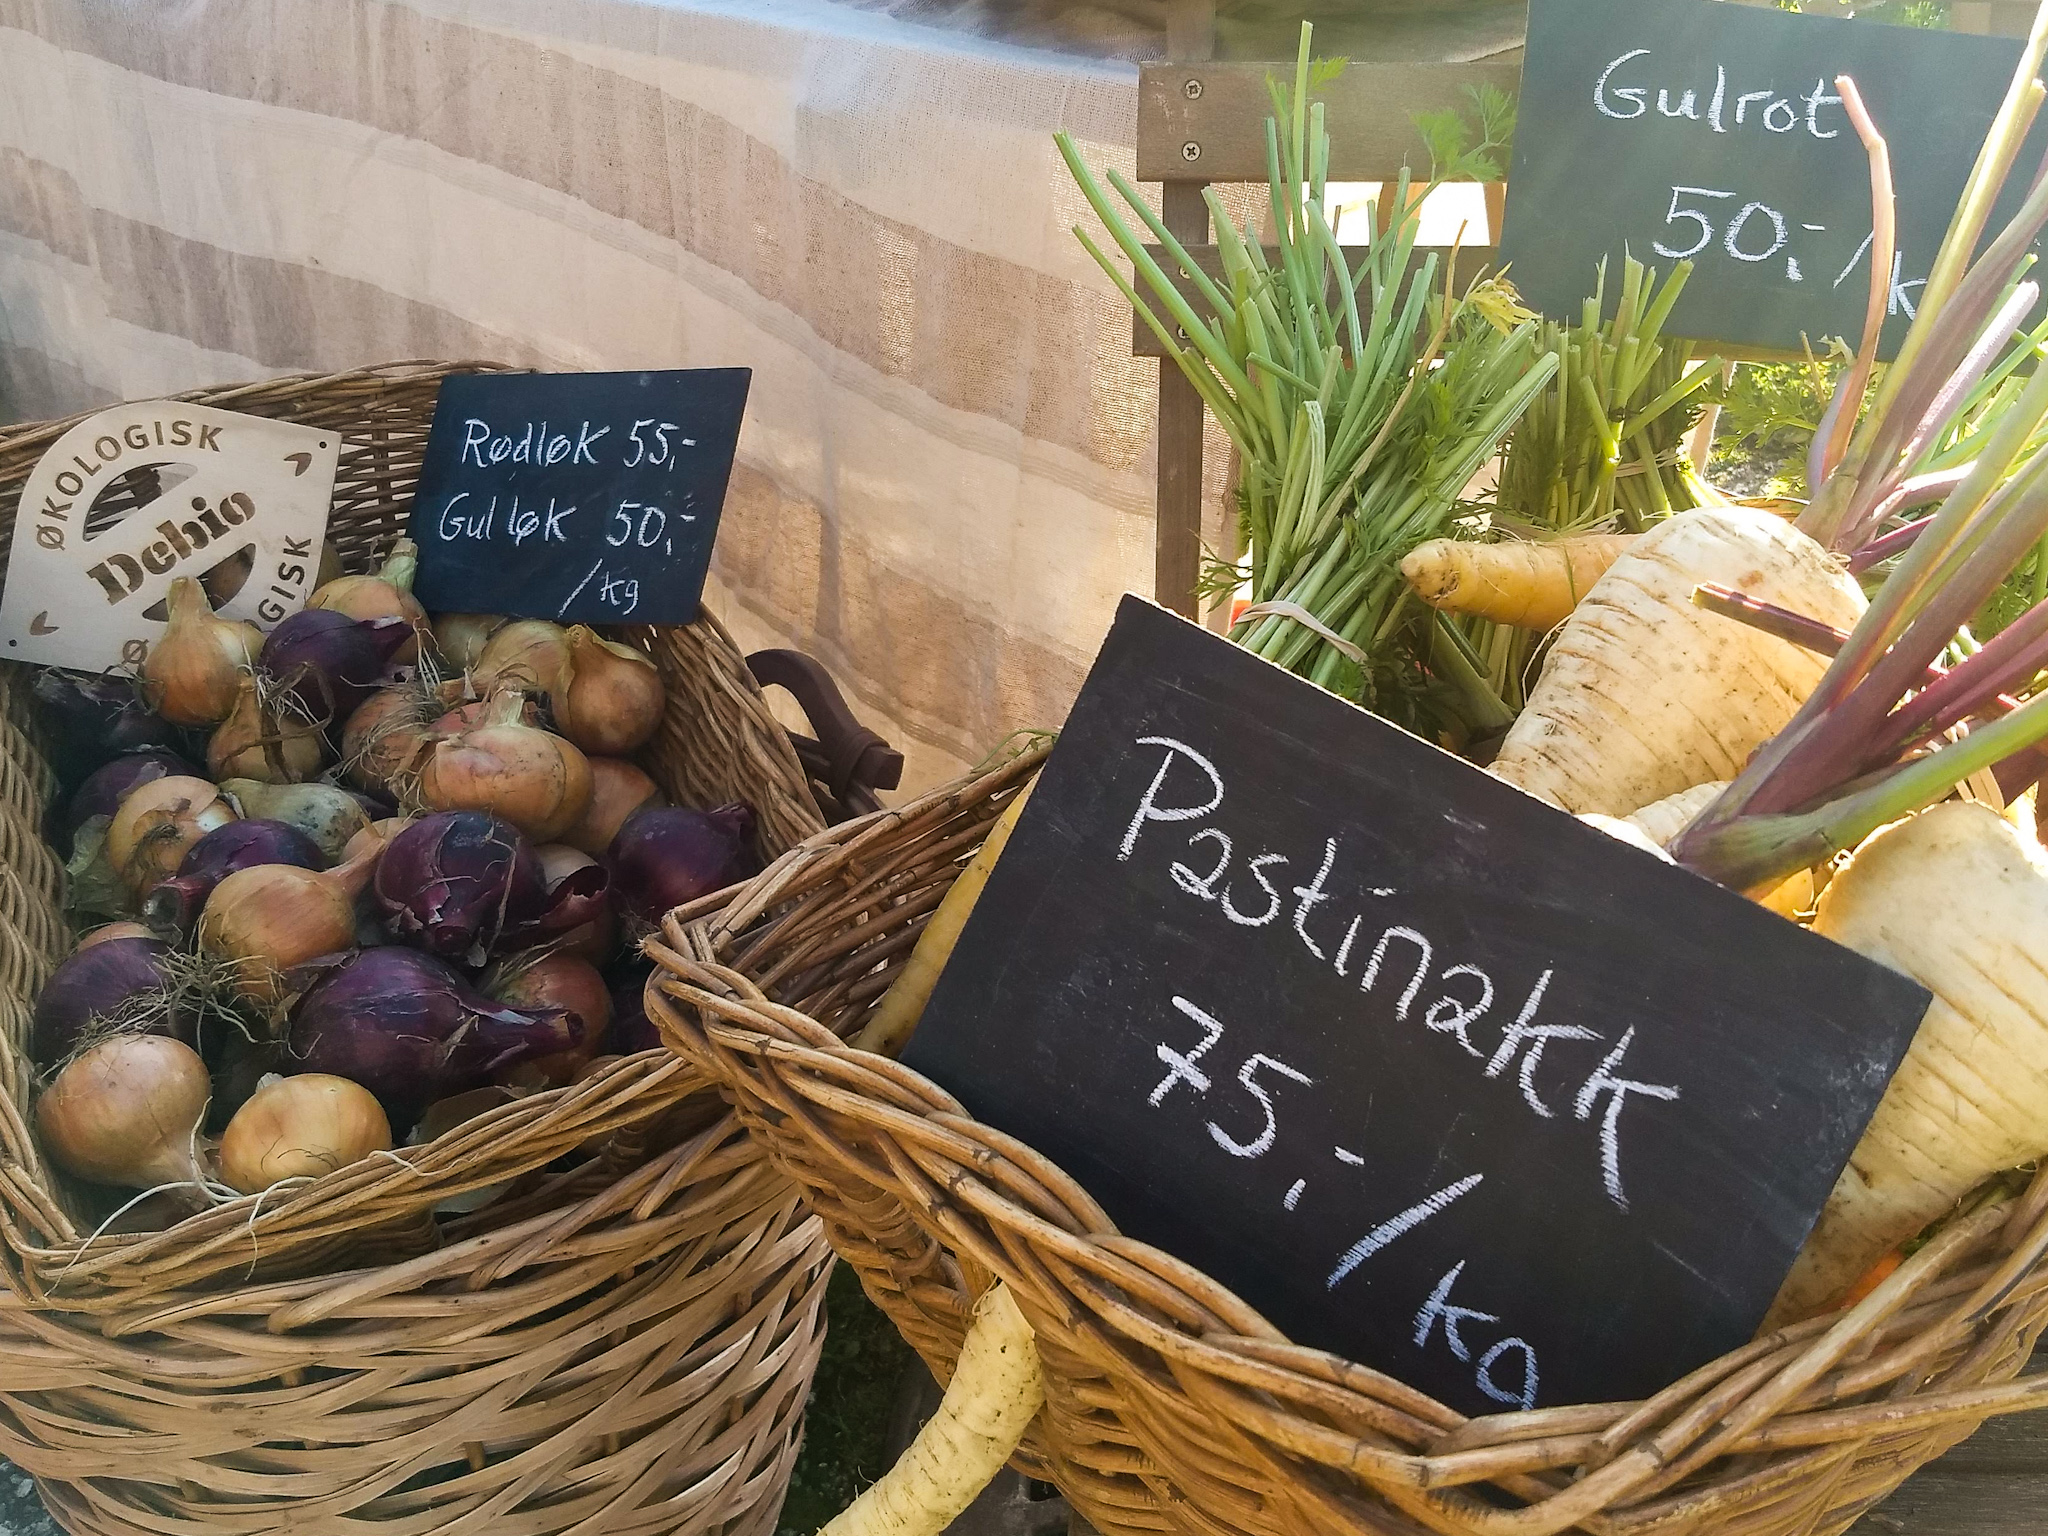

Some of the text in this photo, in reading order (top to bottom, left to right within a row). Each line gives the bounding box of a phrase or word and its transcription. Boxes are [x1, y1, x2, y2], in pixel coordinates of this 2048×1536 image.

[1594, 48, 1842, 139] Gulrot
[36, 420, 223, 551] ØKOLOGISK
[462, 418, 611, 468] Rødløk
[86, 492, 256, 606] Debio
[1116, 735, 1682, 1212] Pastinakk
